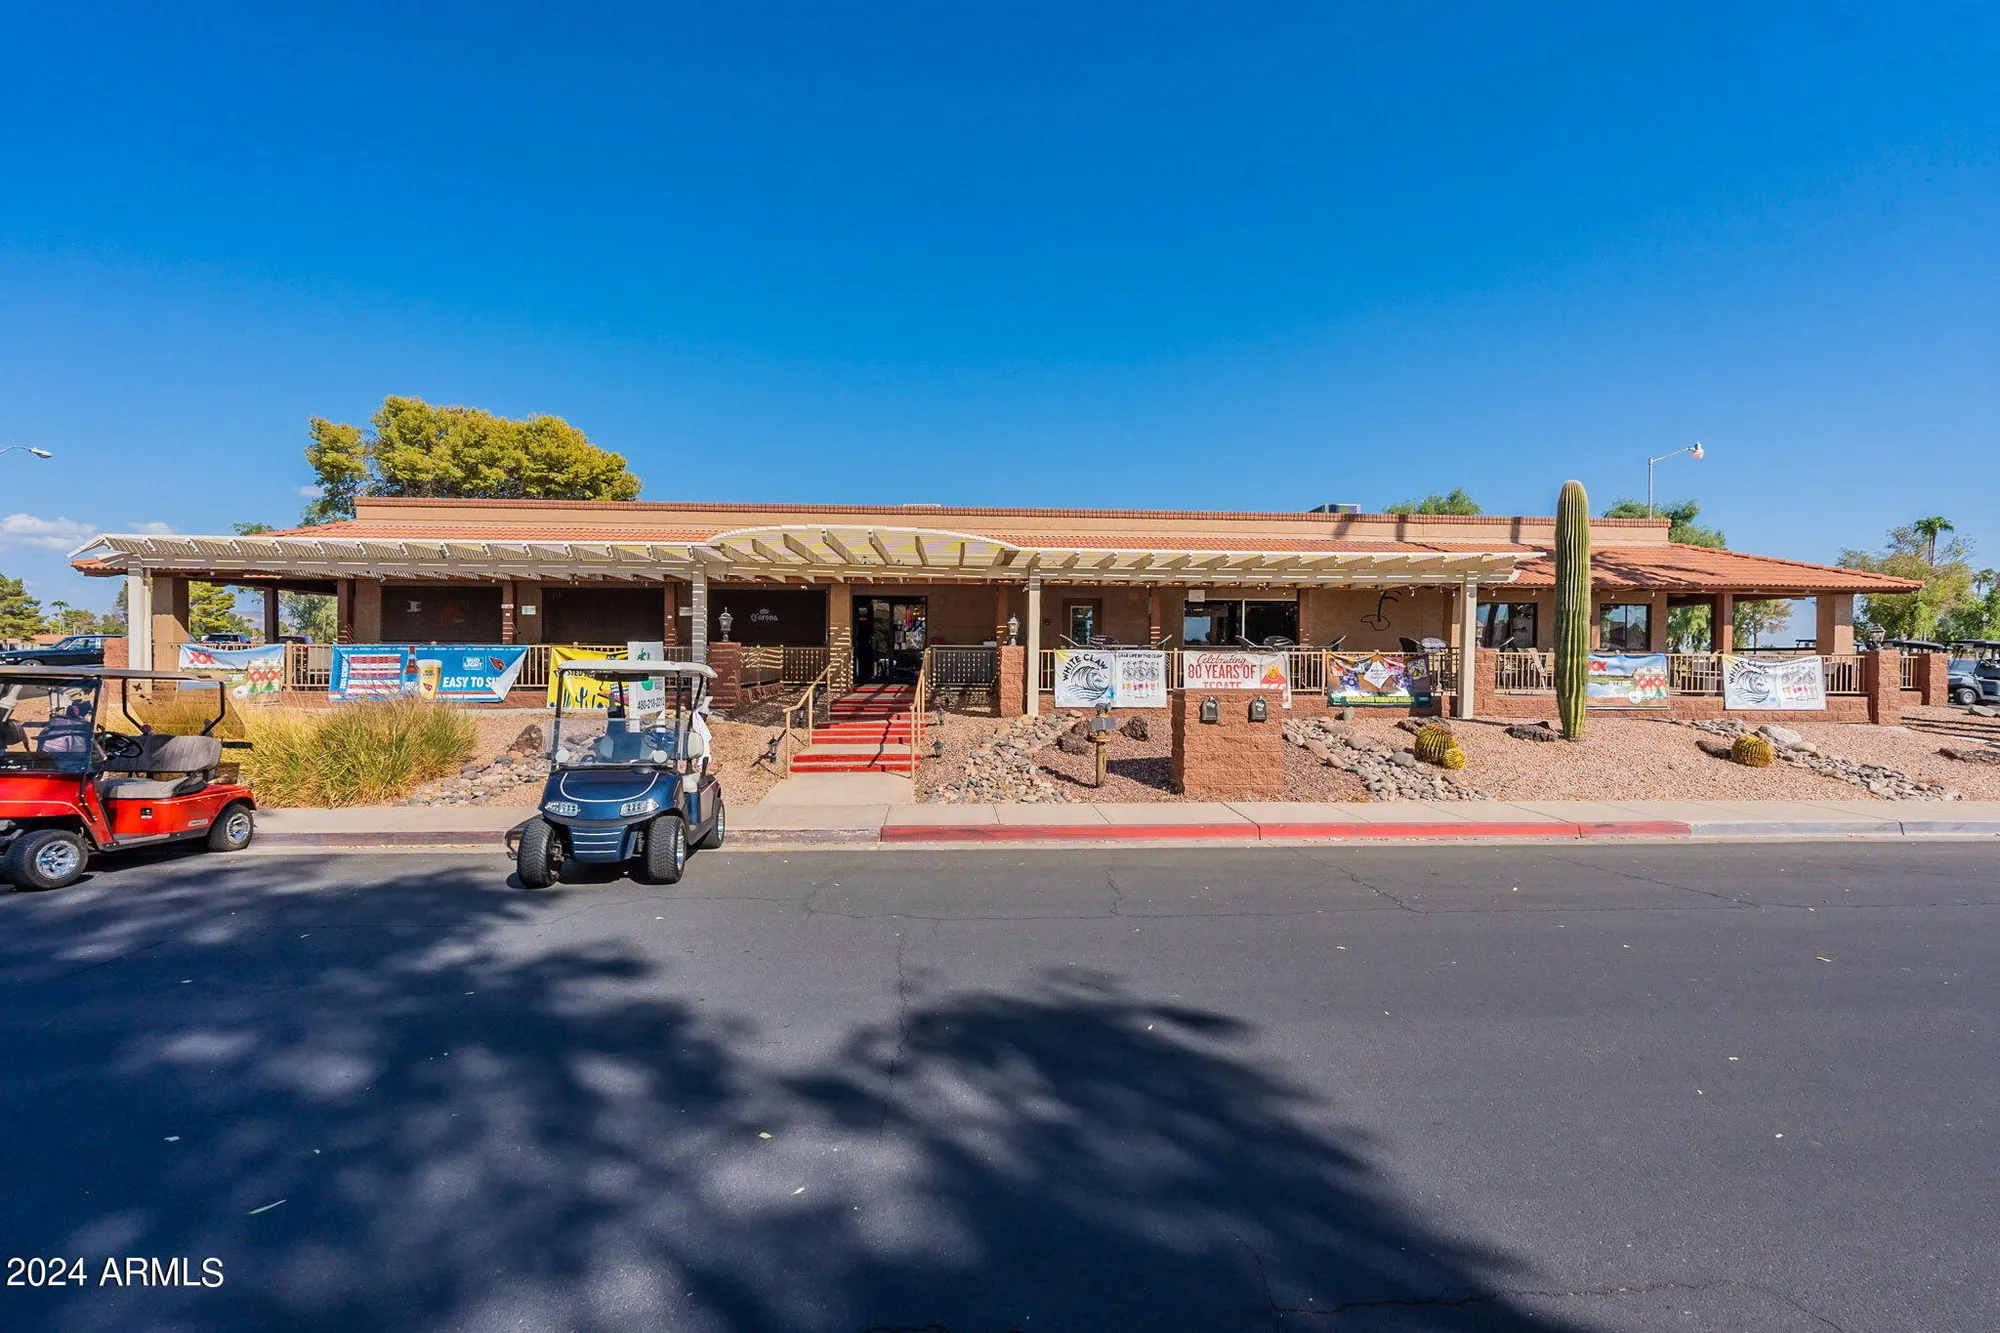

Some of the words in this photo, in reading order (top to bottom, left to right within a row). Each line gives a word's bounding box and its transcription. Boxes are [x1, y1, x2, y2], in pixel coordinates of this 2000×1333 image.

[751, 613, 779, 622] Corona
[1062, 655, 1082, 682] WHITE
[1083, 653, 1108, 670] CLAW
[1197, 654, 1247, 669] Celebrating
[1188, 664, 1202, 679] 80
[1205, 664, 1240, 679] YEARS
[1242, 664, 1257, 679] OF
[1728, 661, 1746, 684] WHITE
[442, 676, 469, 688] EASY
[470, 676, 484, 688] TO
